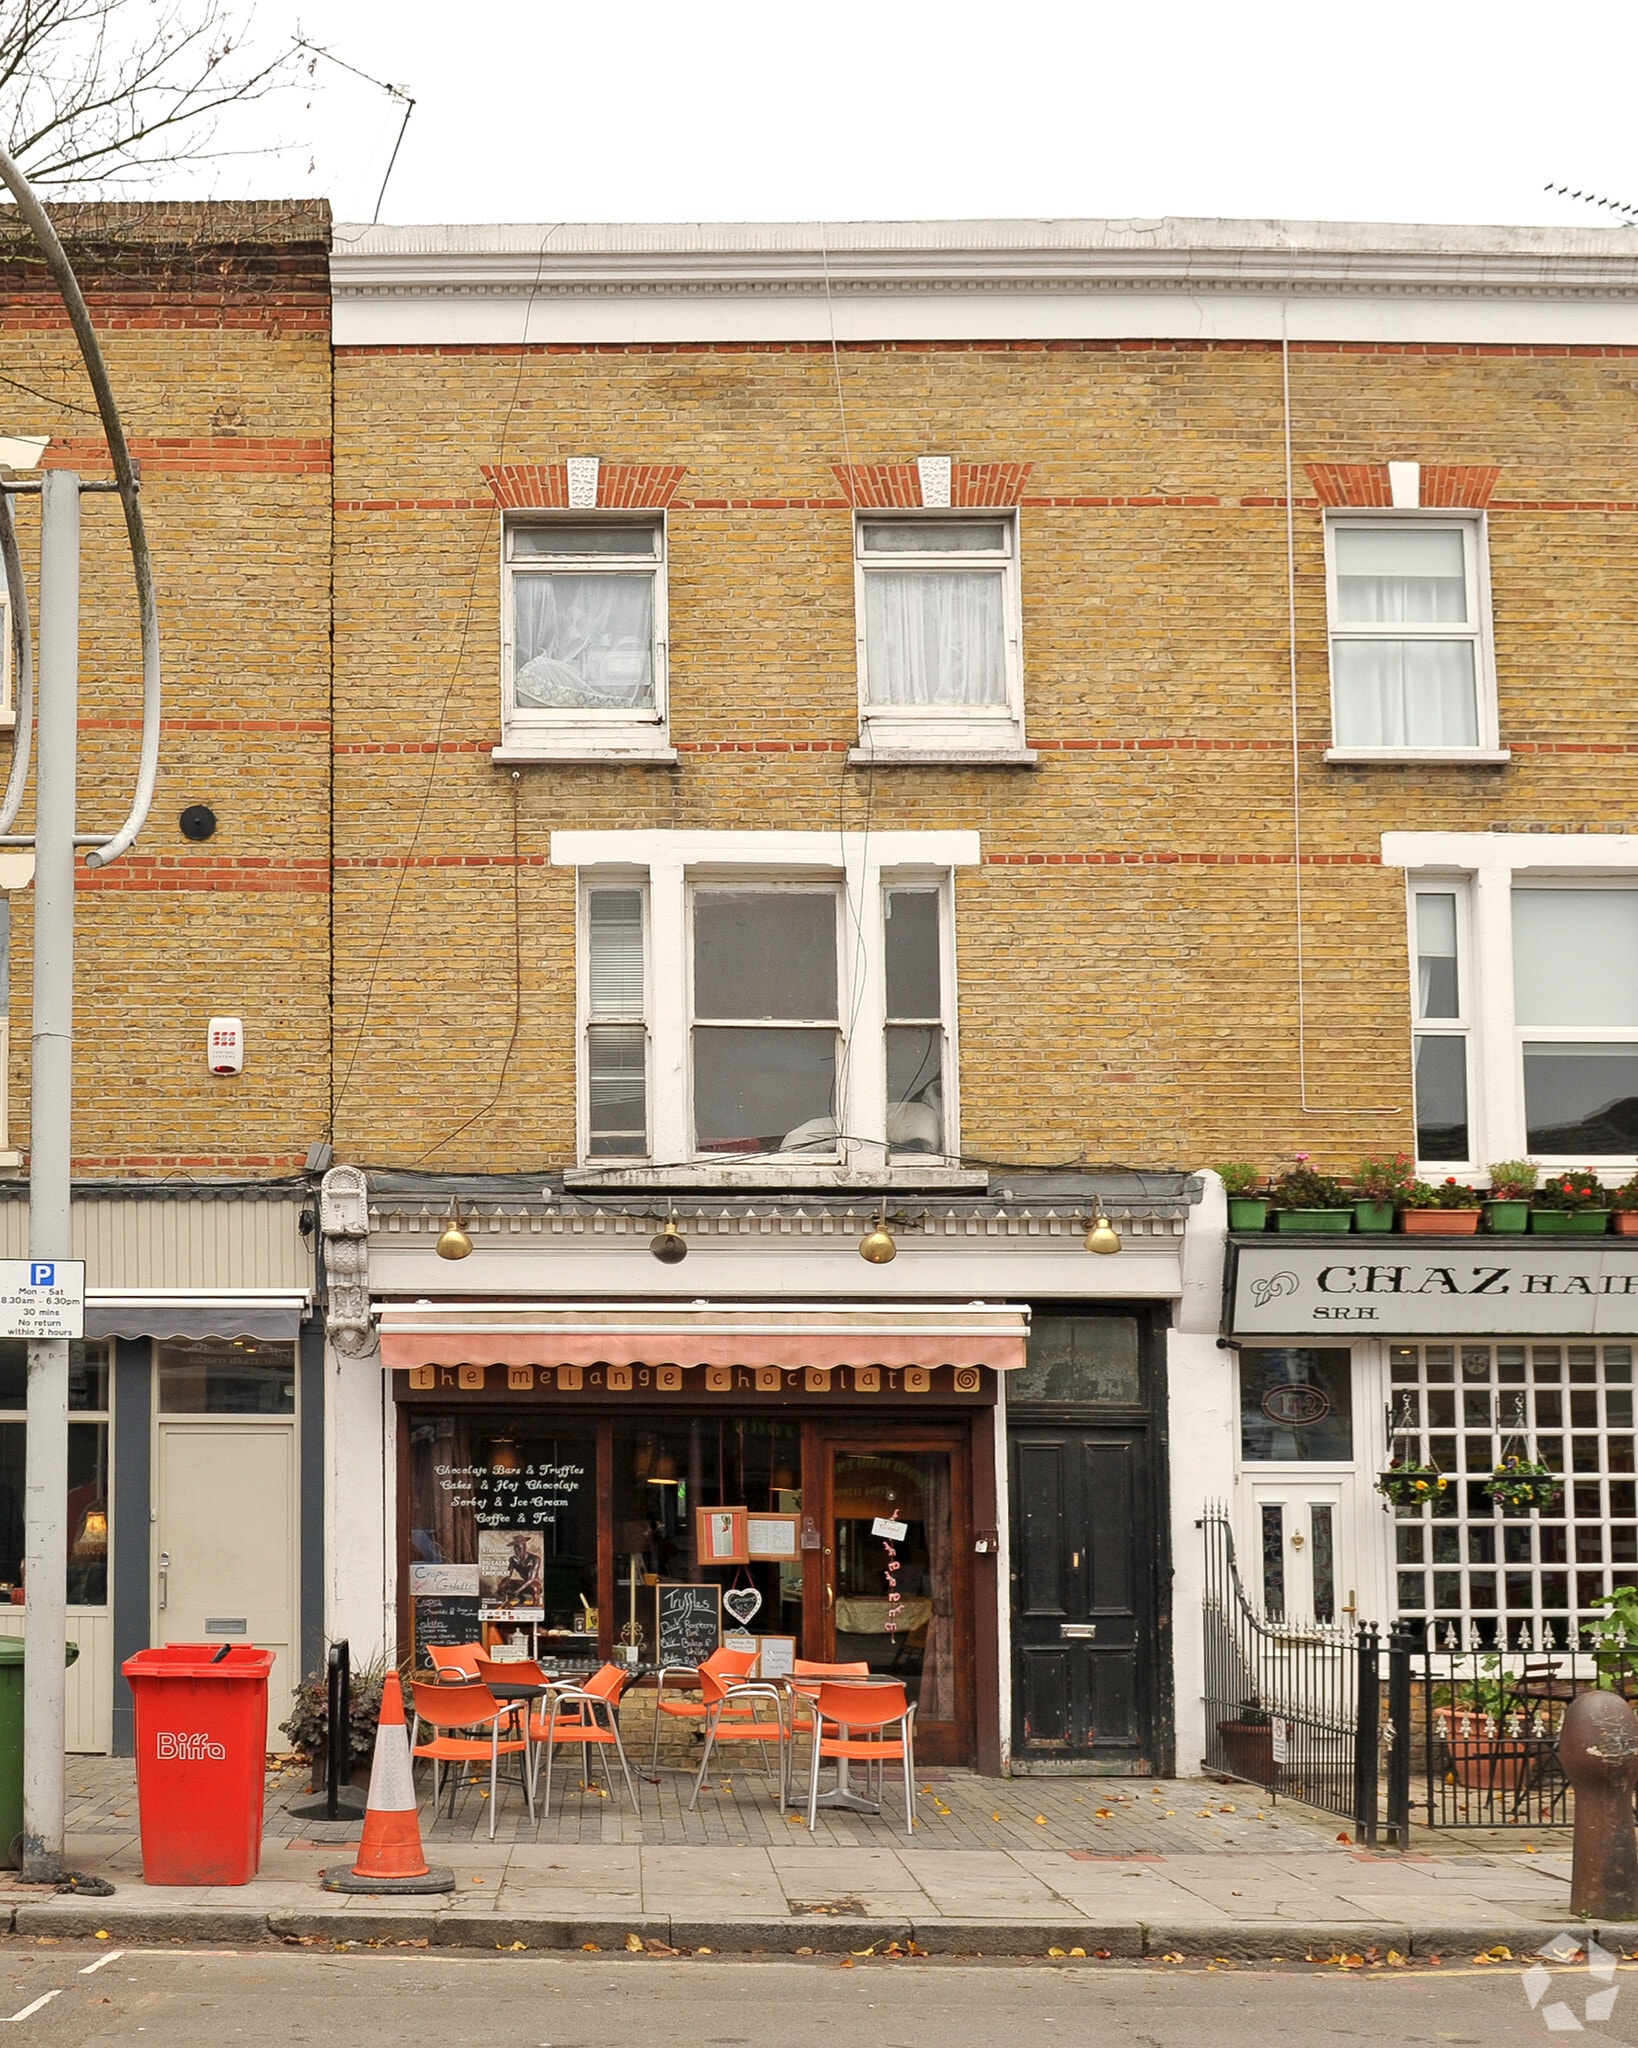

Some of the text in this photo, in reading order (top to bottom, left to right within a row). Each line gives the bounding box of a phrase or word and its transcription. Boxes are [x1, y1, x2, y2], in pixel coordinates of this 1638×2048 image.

[35, 1265, 51, 1284] P
[1316, 1265, 1512, 1294] CHAZ
[48, 1288, 64, 1296] Sat
[46, 1297, 80, 1306] 6.30pm
[23, 1308, 36, 1316] 30
[1312, 1306, 1380, 1320] SRH
[18, 1319, 61, 1327] No return
[416, 1367, 924, 1389] the melange chocolate
[434, 1464, 584, 1478] Chocolate Bars & Truffles
[440, 1480, 579, 1492] Cakes & Hot Chocolate
[450, 1496, 487, 1509] Sorbet
[494, 1496, 502, 1507] &
[474, 1512, 555, 1526] Coffee & Tea
[664, 1588, 710, 1618] Truffles
[157, 1732, 226, 1760] Biffa
